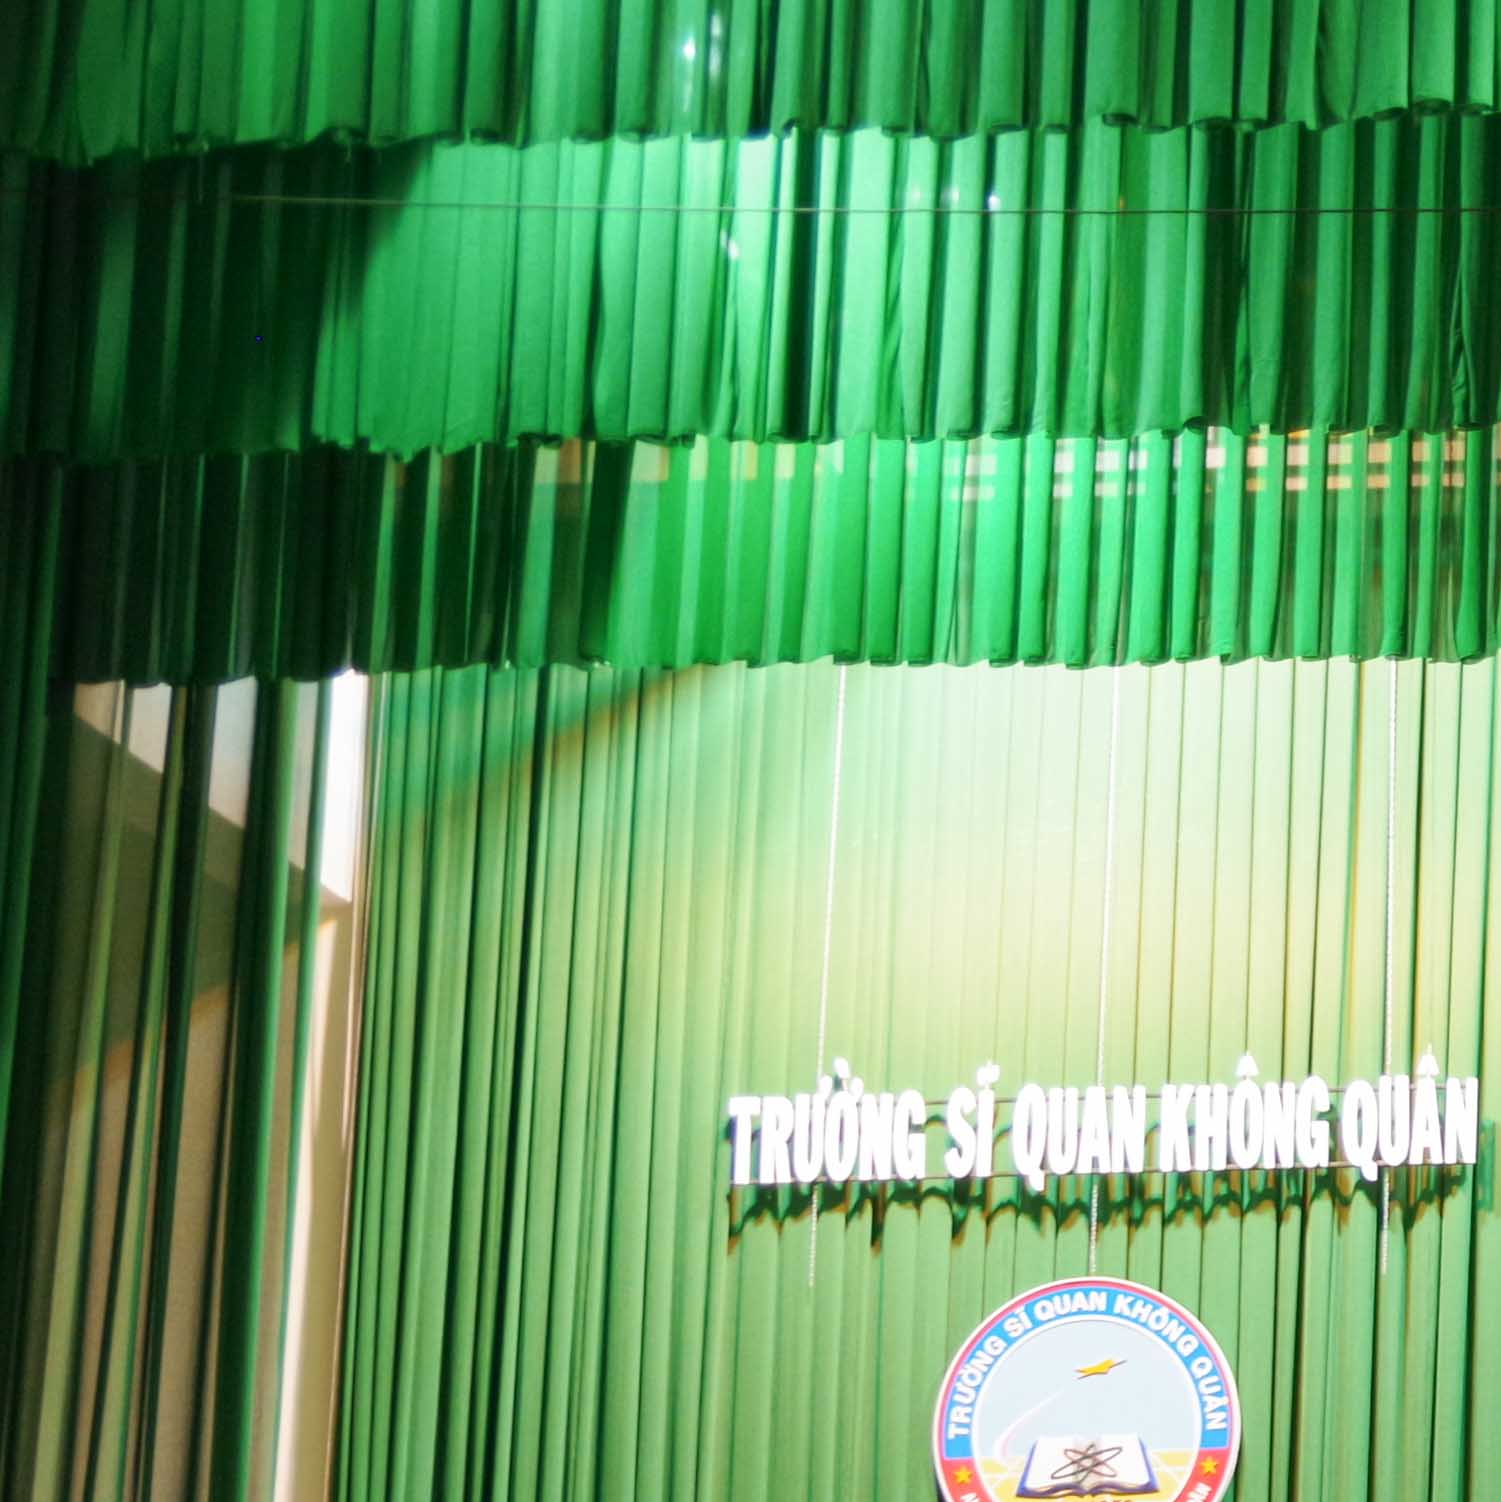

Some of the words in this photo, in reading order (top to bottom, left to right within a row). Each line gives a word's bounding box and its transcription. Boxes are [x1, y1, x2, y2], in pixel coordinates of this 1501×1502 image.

[729, 1057, 926, 1185] TRƯỜNG
[944, 1062, 999, 1178] SĨ
[1012, 1083, 1146, 1191] QUAN
[1159, 1052, 1329, 1172] KHÔNG
[1341, 1048, 1478, 1181] QUÂN
[948, 1336, 1006, 1439] TRƯỜNG
[1034, 1291, 1107, 1321] QUAN
[1113, 1294, 1198, 1356] KHÔNG
[1190, 1357, 1229, 1430] QUÂN
